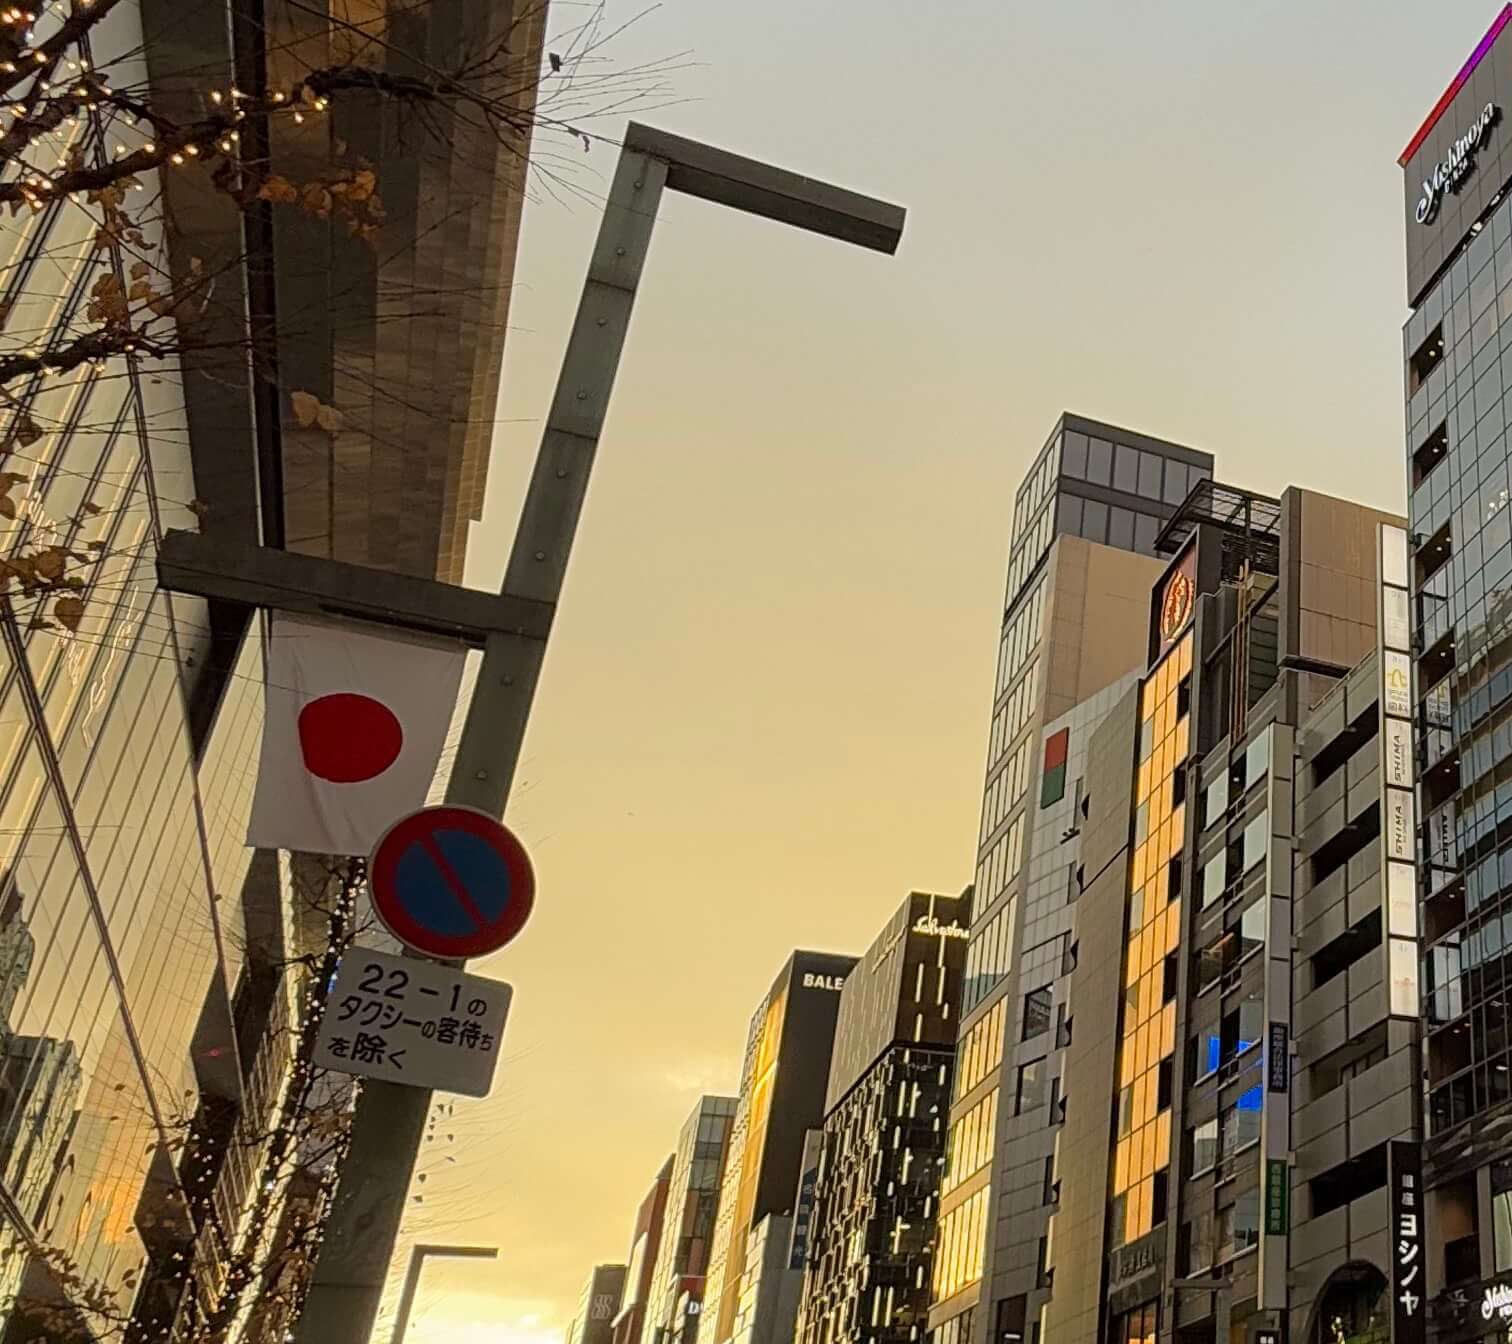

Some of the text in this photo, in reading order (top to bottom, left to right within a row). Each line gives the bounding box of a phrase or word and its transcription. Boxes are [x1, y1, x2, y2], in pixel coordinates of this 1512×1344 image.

[338, 995, 495, 1052] タクシーの客待ち
[328, 1032, 407, 1069] を除く
